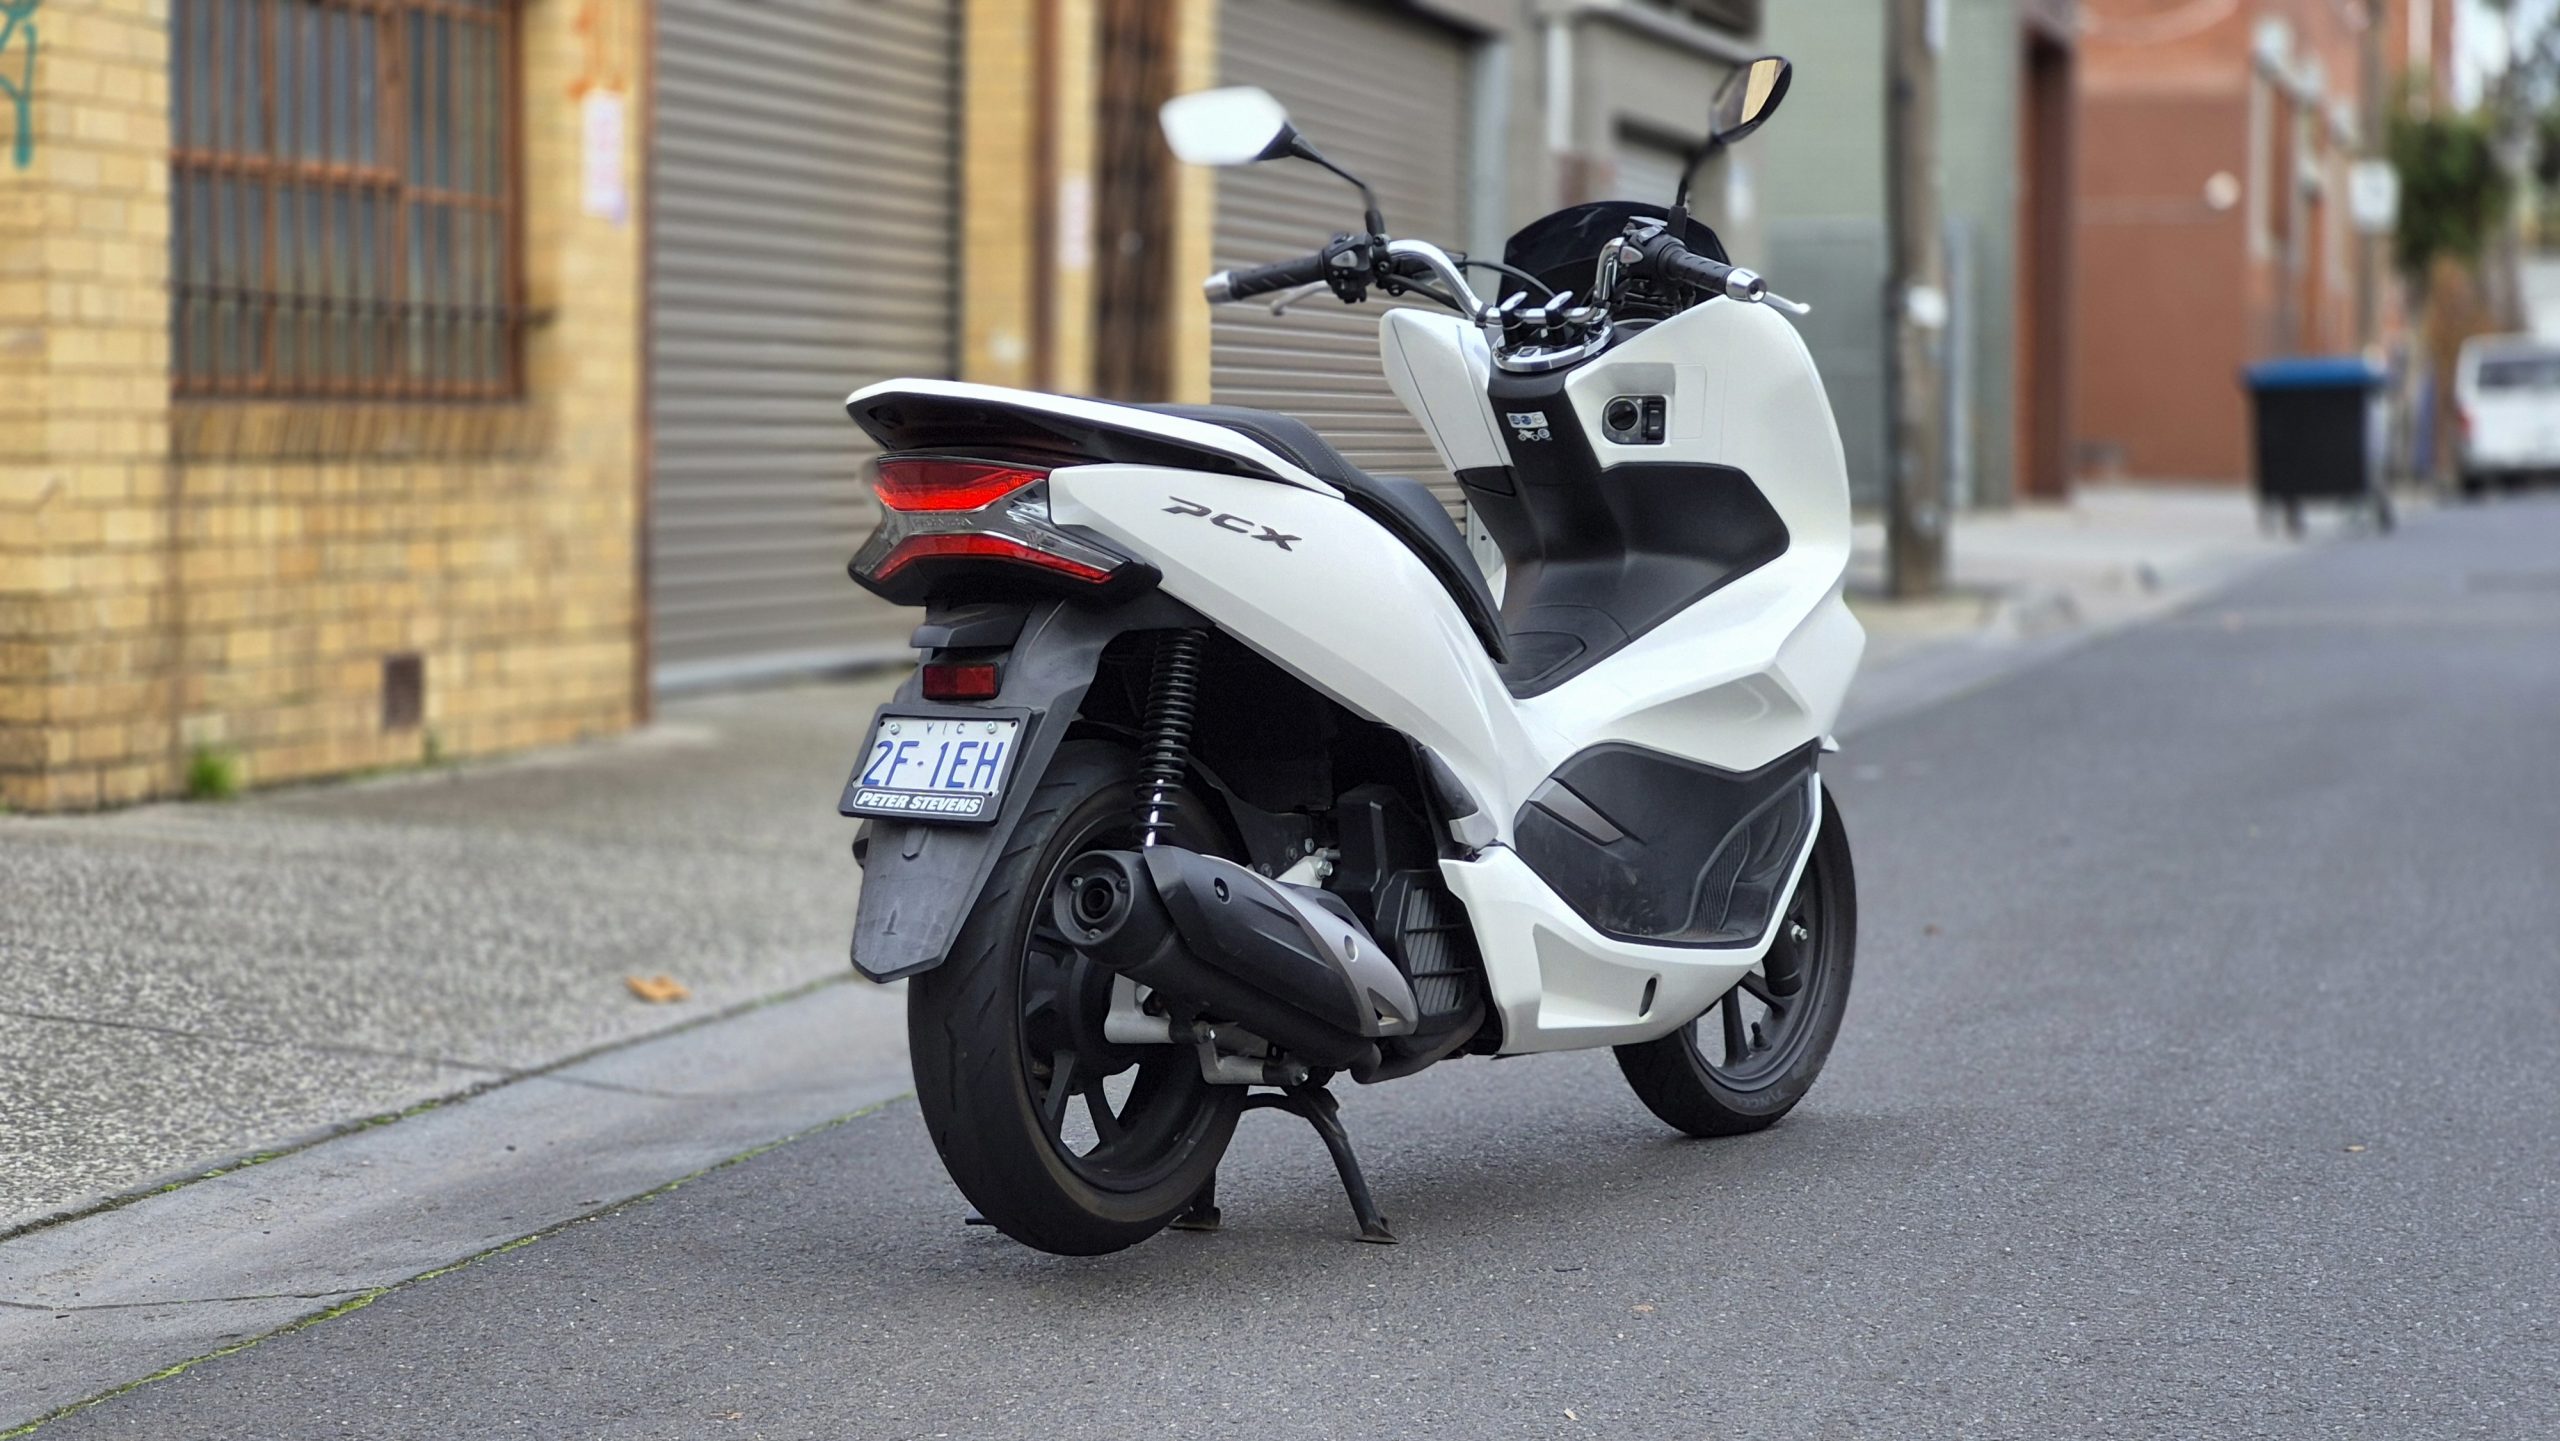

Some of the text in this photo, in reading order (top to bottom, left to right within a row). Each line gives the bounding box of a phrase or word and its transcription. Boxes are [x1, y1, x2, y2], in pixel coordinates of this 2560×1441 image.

[1161, 496, 1302, 552] PCX
[925, 722, 966, 735] VIC
[857, 791, 982, 813] PETER STEVENS
